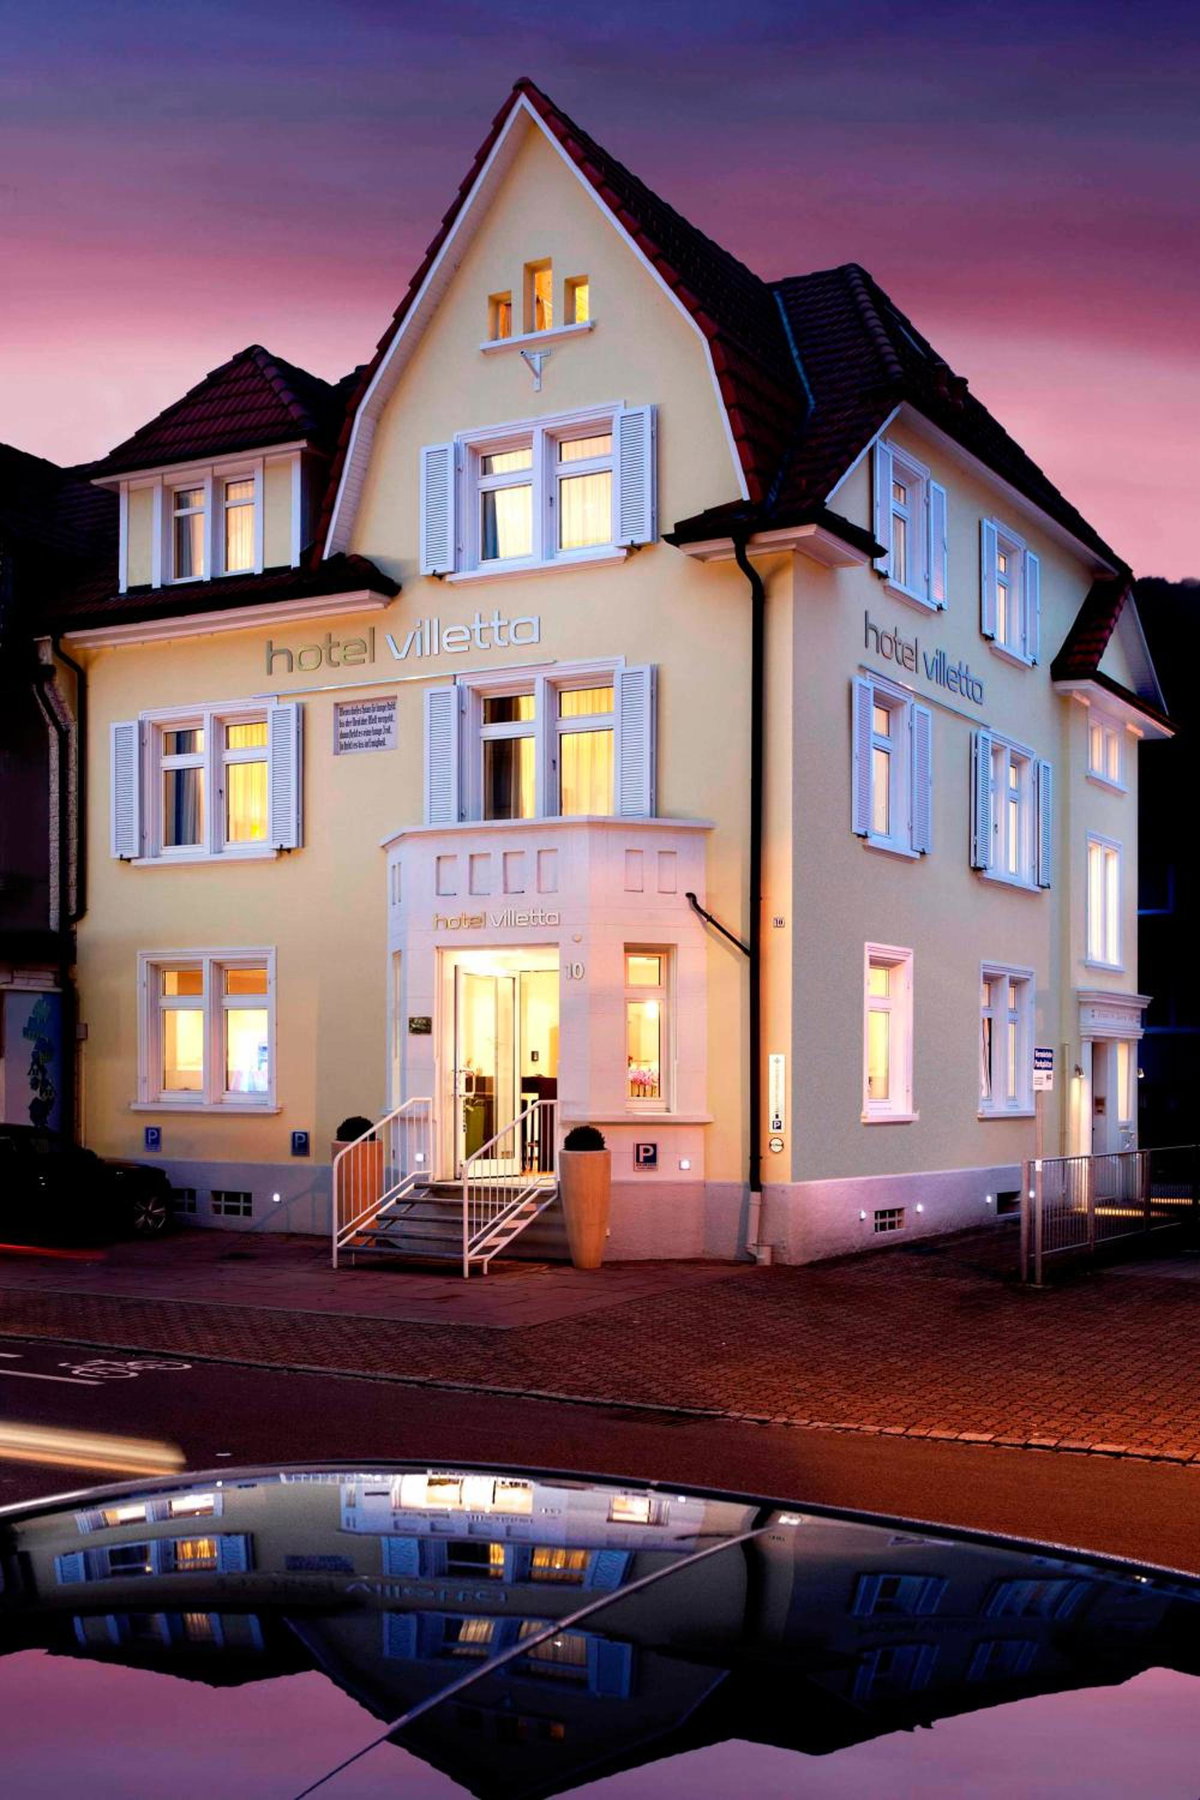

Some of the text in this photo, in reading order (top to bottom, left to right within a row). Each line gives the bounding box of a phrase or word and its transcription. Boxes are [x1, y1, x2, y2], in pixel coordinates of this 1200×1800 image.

[265, 608, 541, 676] hotel villetta
[864, 610, 983, 705] hotel villetta
[434, 907, 561, 930] hotel villetta
[566, 961, 586, 981] 10
[148, 1129, 158, 1144] P
[295, 1133, 306, 1147] P
[639, 1145, 654, 1162] P
